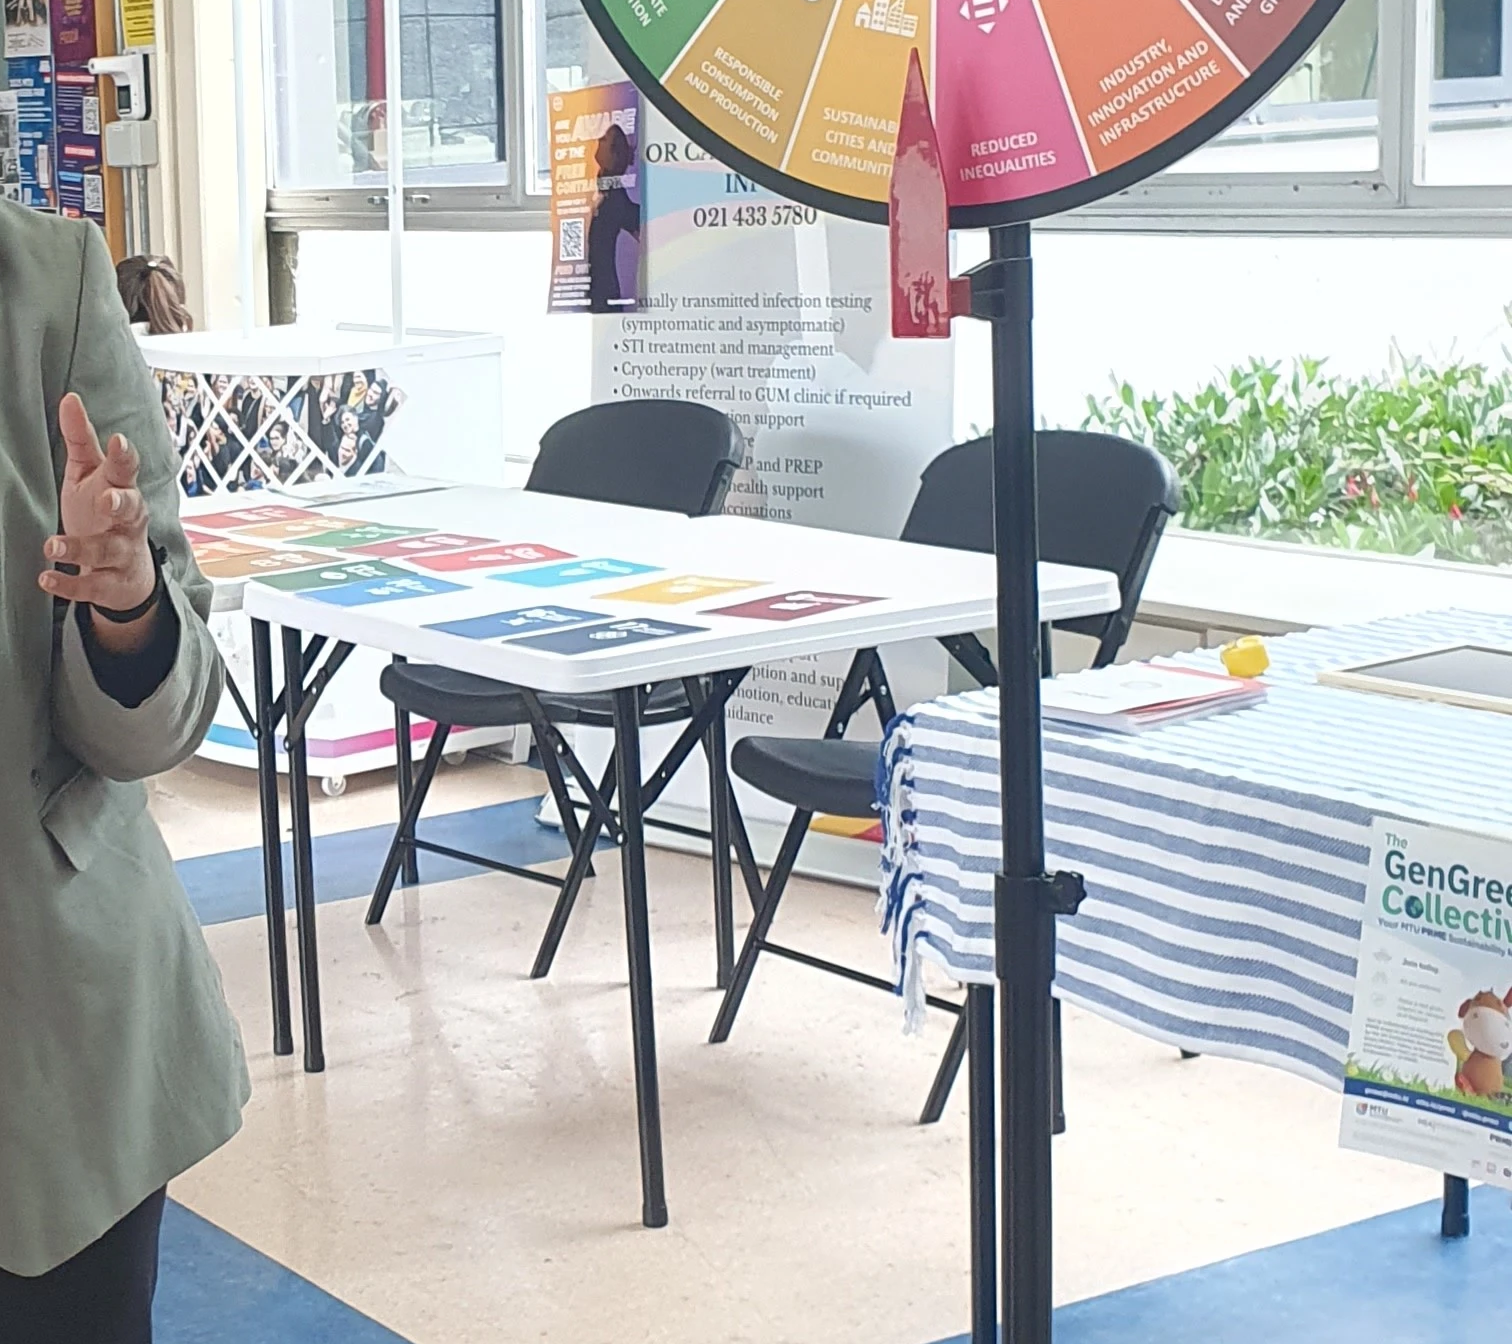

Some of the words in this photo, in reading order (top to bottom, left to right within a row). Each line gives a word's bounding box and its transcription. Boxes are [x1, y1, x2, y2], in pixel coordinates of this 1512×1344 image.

[713, 46, 784, 103] RESPONSIBLE
[1099, 37, 1173, 94] INDUSTRY,
[700, 60, 780, 123] CONSUMPTION
[1087, 60, 1177, 128] INNOVATION
[1177, 39, 1210, 70] AND
[685, 71, 712, 97] AND
[707, 88, 779, 145] PRODUCTION
[1098, 59, 1222, 148] INFRASTRUCTURE
[822, 106, 898, 134] SUSTAINAB
[825, 130, 865, 151] CITIES
[971, 130, 1038, 158] REDUCED
[811, 148, 894, 177] COMMUNIT
[959, 150, 1057, 182] INEQUALITIES
[693, 207, 728, 228] 021
[732, 206, 768, 227] 433
[771, 205, 818, 226] 5780
[682, 292, 759, 309] transmitted
[762, 293, 824, 310] infection
[825, 294, 873, 313] testing
[621, 315, 717, 335] (symptomatic
[718, 316, 743, 332] and
[745, 316, 846, 336] asymptomatic)
[621, 340, 646, 354] STI
[647, 342, 717, 355] treatment
[718, 340, 744, 355] and
[747, 343, 834, 359] management
[621, 362, 708, 380] Cryotherapy
[710, 363, 745, 380] (wart
[746, 364, 818, 381] treatment)
[621, 384, 683, 399] Onwards
[685, 386, 736, 401] referral
[738, 388, 753, 402] to
[755, 387, 791, 403] GUM
[793, 389, 833, 405] clinic
[834, 390, 846, 405] if
[848, 391, 913, 410] required
[754, 413, 806, 430] support
[756, 457, 781, 473] and
[784, 458, 824, 475] PREP
[772, 484, 825, 502] support
[790, 669, 817, 685] and
[1385, 832, 1409, 850] The
[1400, 921, 1422, 935] MTU
[1448, 933, 1507, 958] Sustainability
